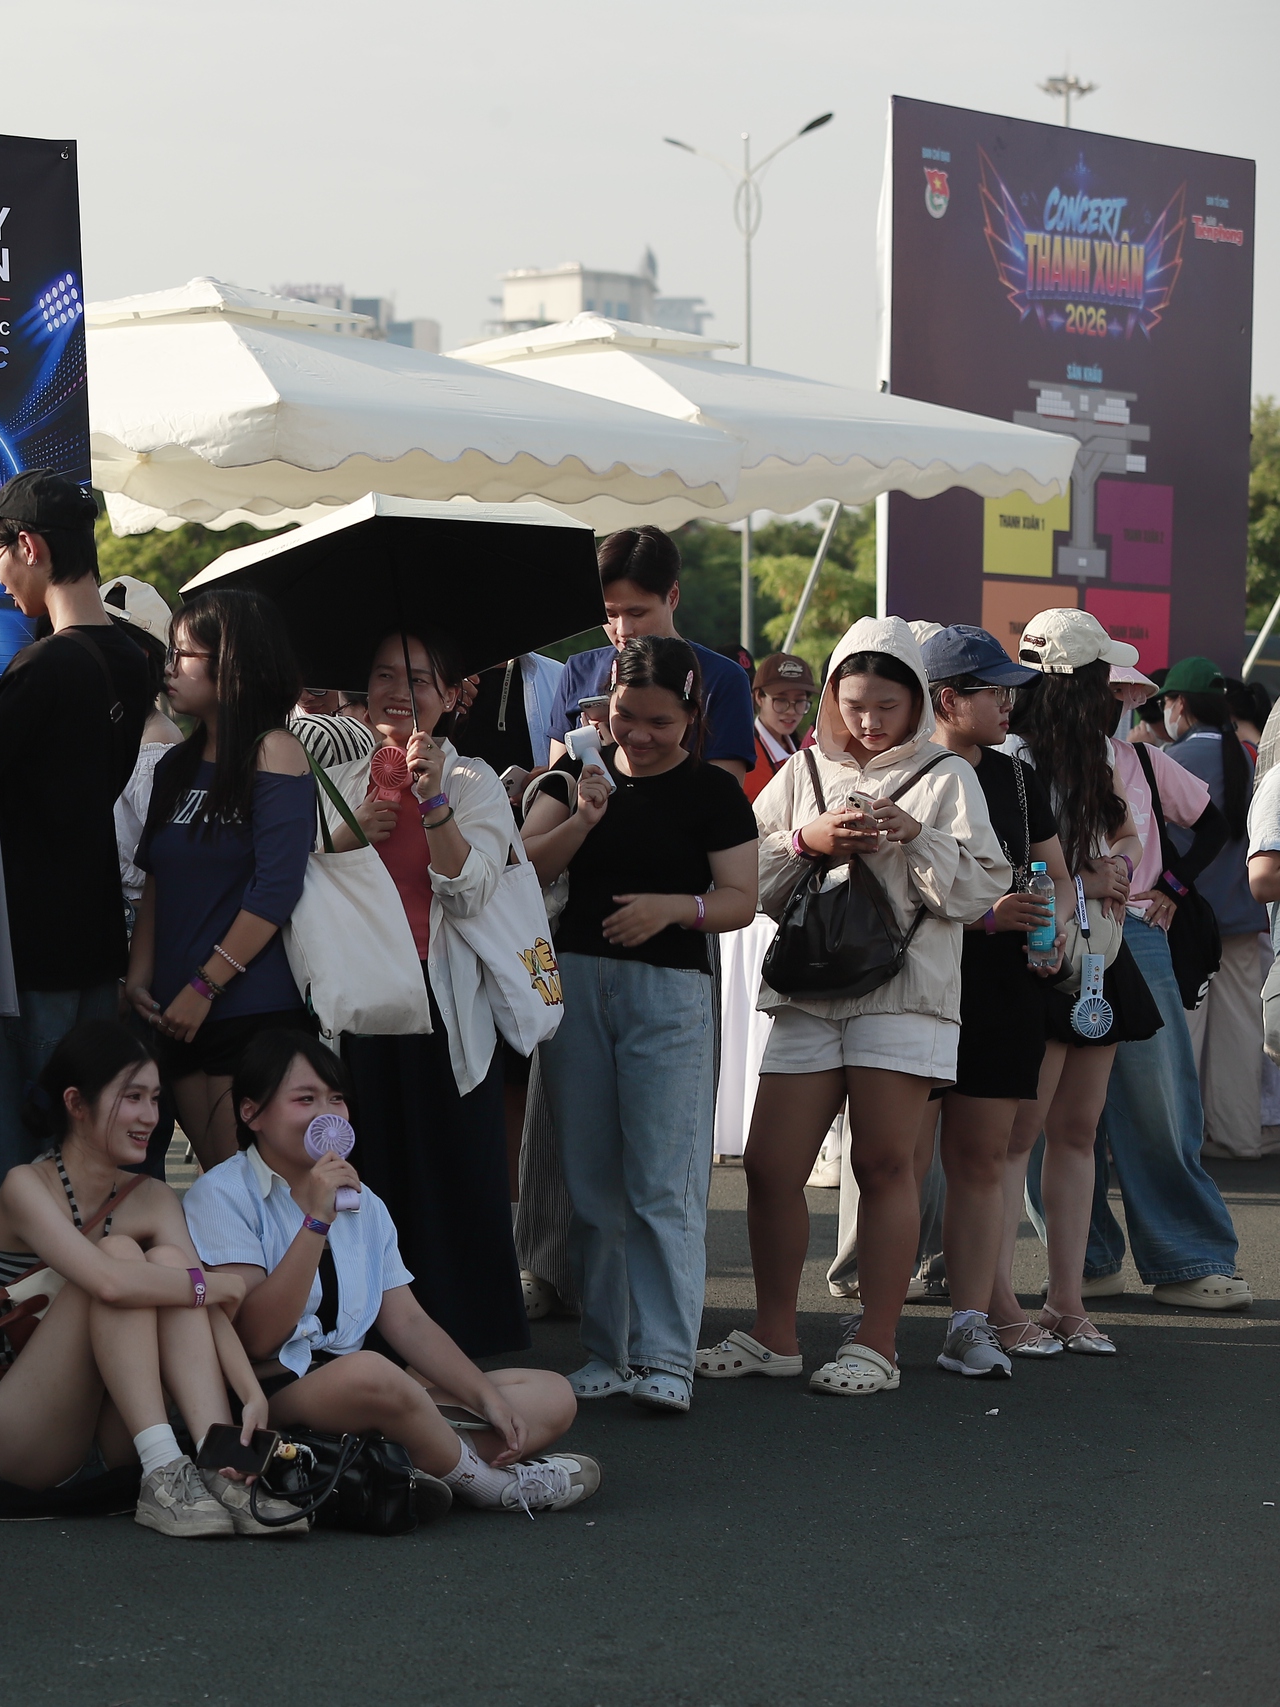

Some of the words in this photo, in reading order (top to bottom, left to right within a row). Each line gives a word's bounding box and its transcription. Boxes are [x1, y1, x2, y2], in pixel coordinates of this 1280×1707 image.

[1043, 187, 1128, 238] CONCERT
[1025, 233, 1091, 294] THANH
[1093, 229, 1146, 300] XUÂN
[1065, 304, 1107, 337] 2026
[999, 514, 1020, 529] THANH
[1041, 518, 1045, 531] 1
